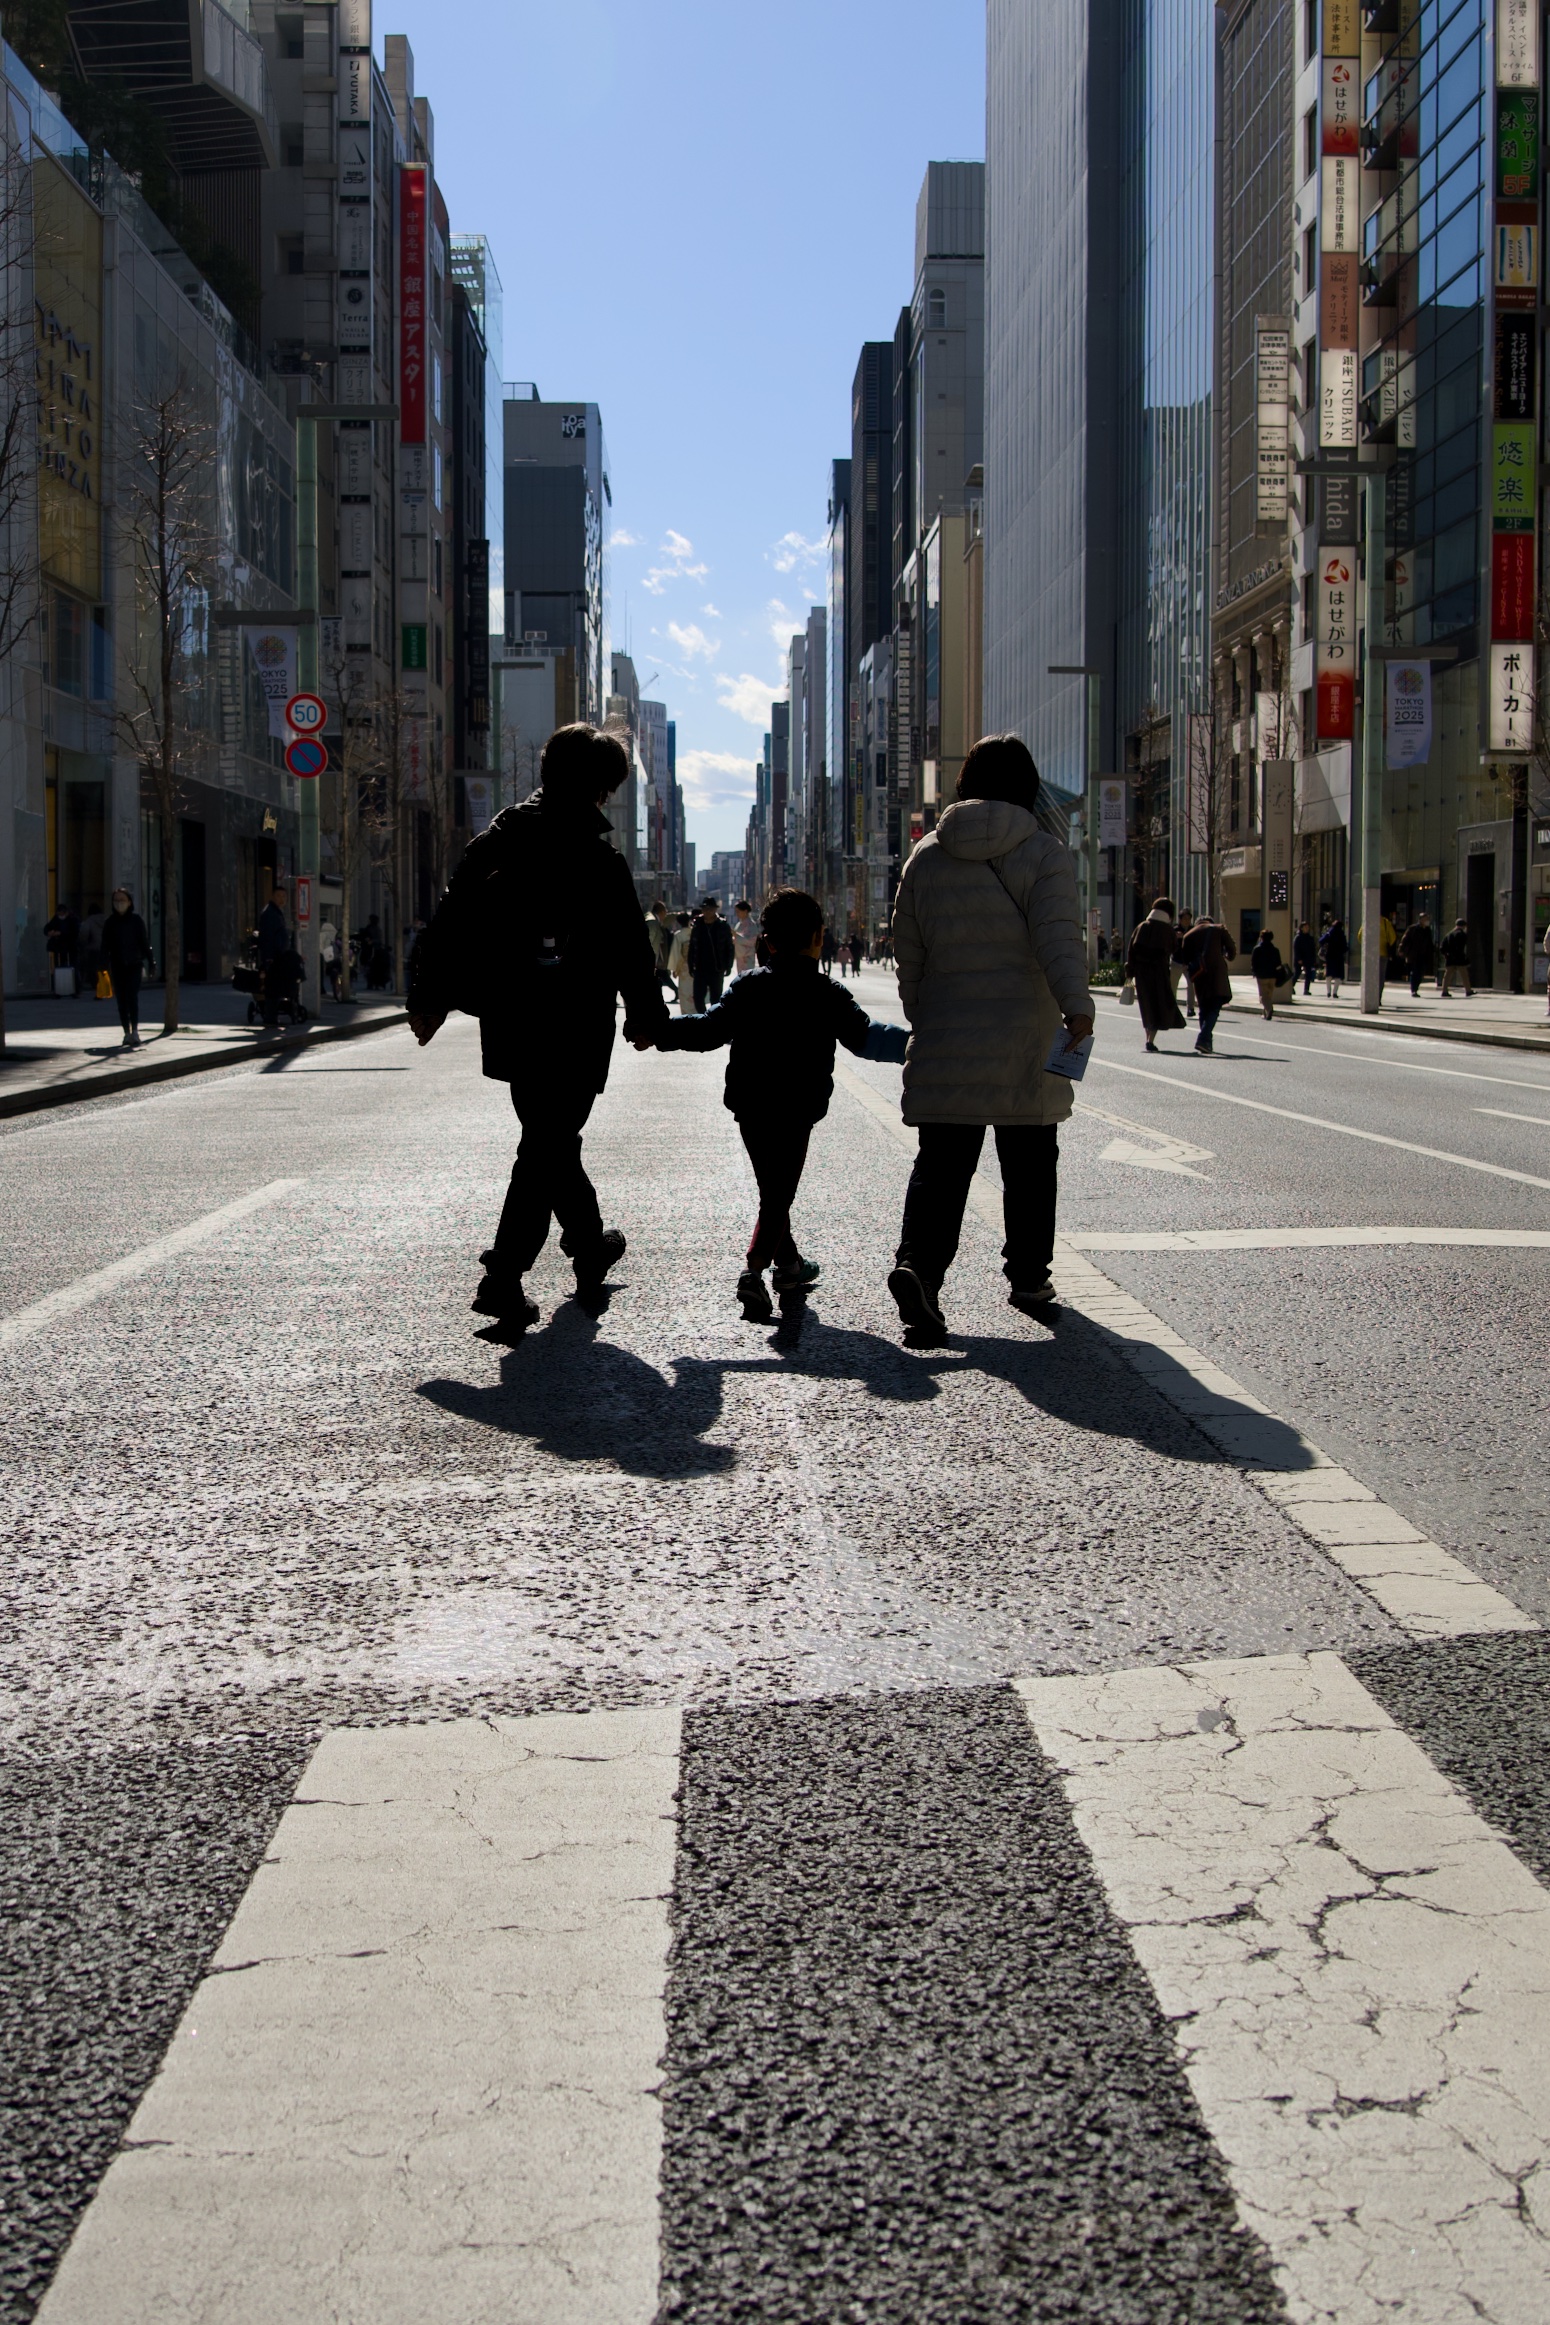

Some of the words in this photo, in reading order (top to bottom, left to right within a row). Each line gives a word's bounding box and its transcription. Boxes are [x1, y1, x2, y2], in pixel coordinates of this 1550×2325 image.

[350, 73, 359, 116] YUTAKA
[1511, 73, 1524, 83] 6F
[1335, 87, 1347, 137] はせがわ
[1521, 96, 1536, 174] マッサージ
[1335, 159, 1345, 250] 新都市総合法律事務所
[1503, 174, 1531, 196] 5F
[405, 210, 419, 264] 中国名菜
[342, 313, 368, 322] Terra
[1329, 293, 1337, 333] クリニック
[403, 275, 421, 403] 銀座アスター
[342, 358, 369, 366] GINZA
[1323, 388, 1334, 442] クリニック
[1325, 452, 1350, 530] Ihida
[1497, 440, 1525, 503] 悠楽
[1506, 517, 1523, 529] 2F
[1327, 590, 1346, 659] はせがわ
[261, 670, 287, 679] OKYO
[1503, 653, 1520, 731] ポーカー
[294, 704, 318, 723] 50
[1330, 685, 1340, 723] 銀座本店
[1394, 698, 1424, 706] TOKYO
[1394, 710, 1424, 721] 2025
[1505, 738, 1517, 747] B1
